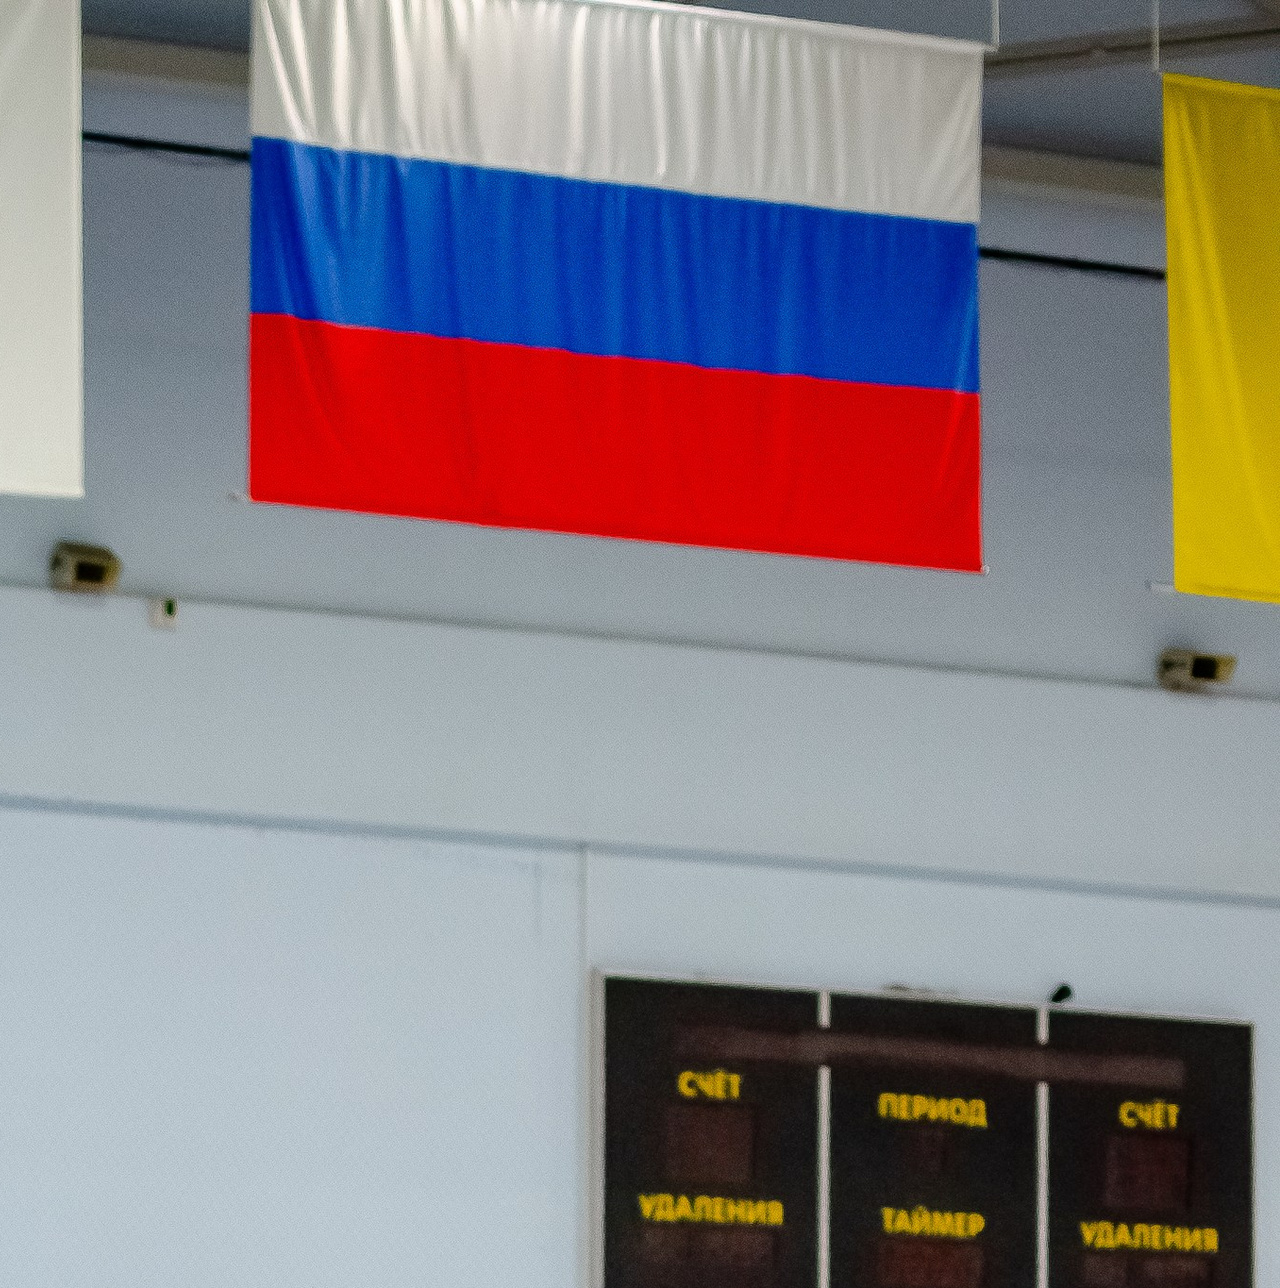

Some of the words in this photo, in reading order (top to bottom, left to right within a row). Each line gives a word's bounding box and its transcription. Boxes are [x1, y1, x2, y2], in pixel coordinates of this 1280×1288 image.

[677, 1069, 742, 1100] СЧЁТ
[877, 1092, 988, 1128] ПЕРИОД
[1119, 1099, 1179, 1130] СЧЁТ
[638, 1194, 784, 1226] УДАЛЕНИЯ
[881, 1205, 986, 1239] ТАЙМЕР
[1080, 1220, 1219, 1253] УДАЛЕНИЯ
